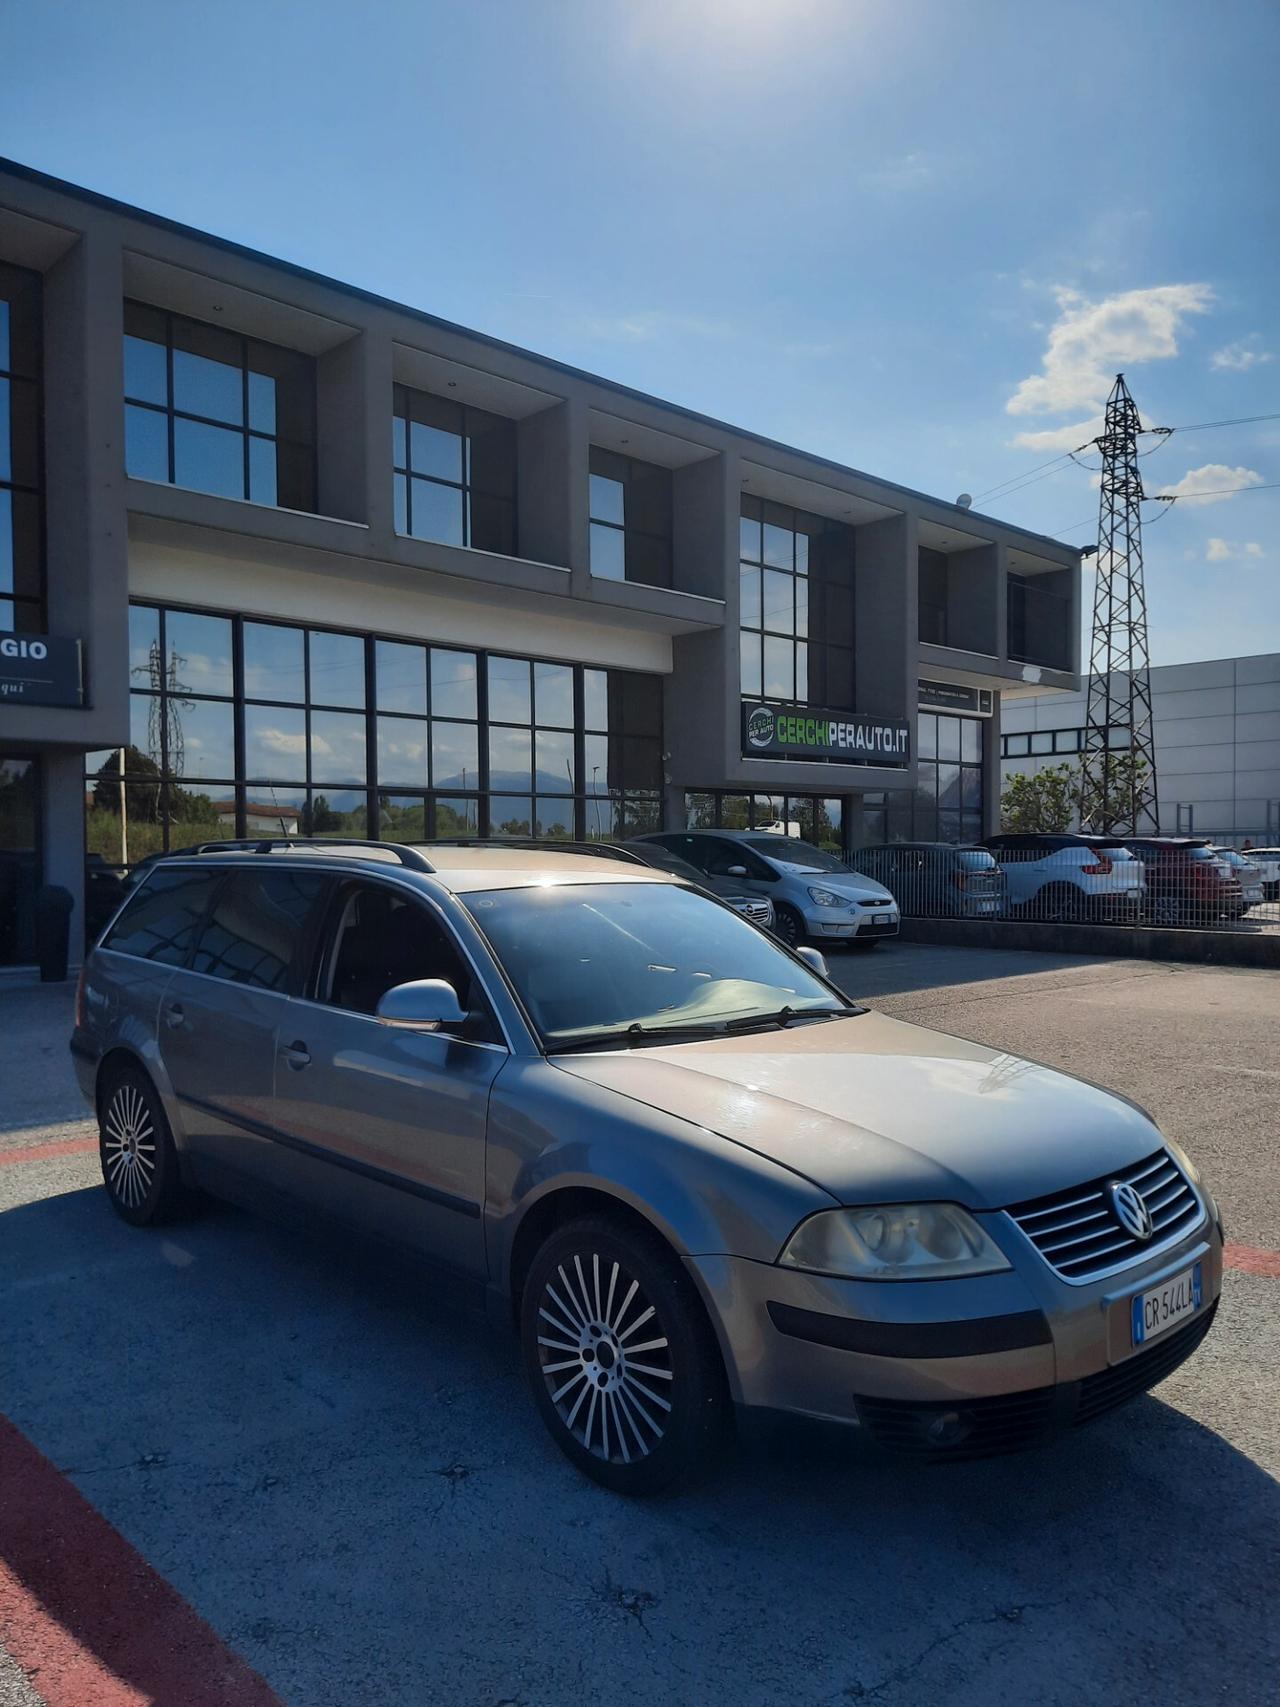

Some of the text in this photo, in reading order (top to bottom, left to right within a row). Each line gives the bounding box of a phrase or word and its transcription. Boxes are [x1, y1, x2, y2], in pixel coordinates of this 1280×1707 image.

[748, 716, 774, 731] CERCHI
[748, 724, 774, 738] PER AUTO
[777, 715, 908, 753] CERCHIPERAUTO.IT
[1111, 1182, 1153, 1239] VW
